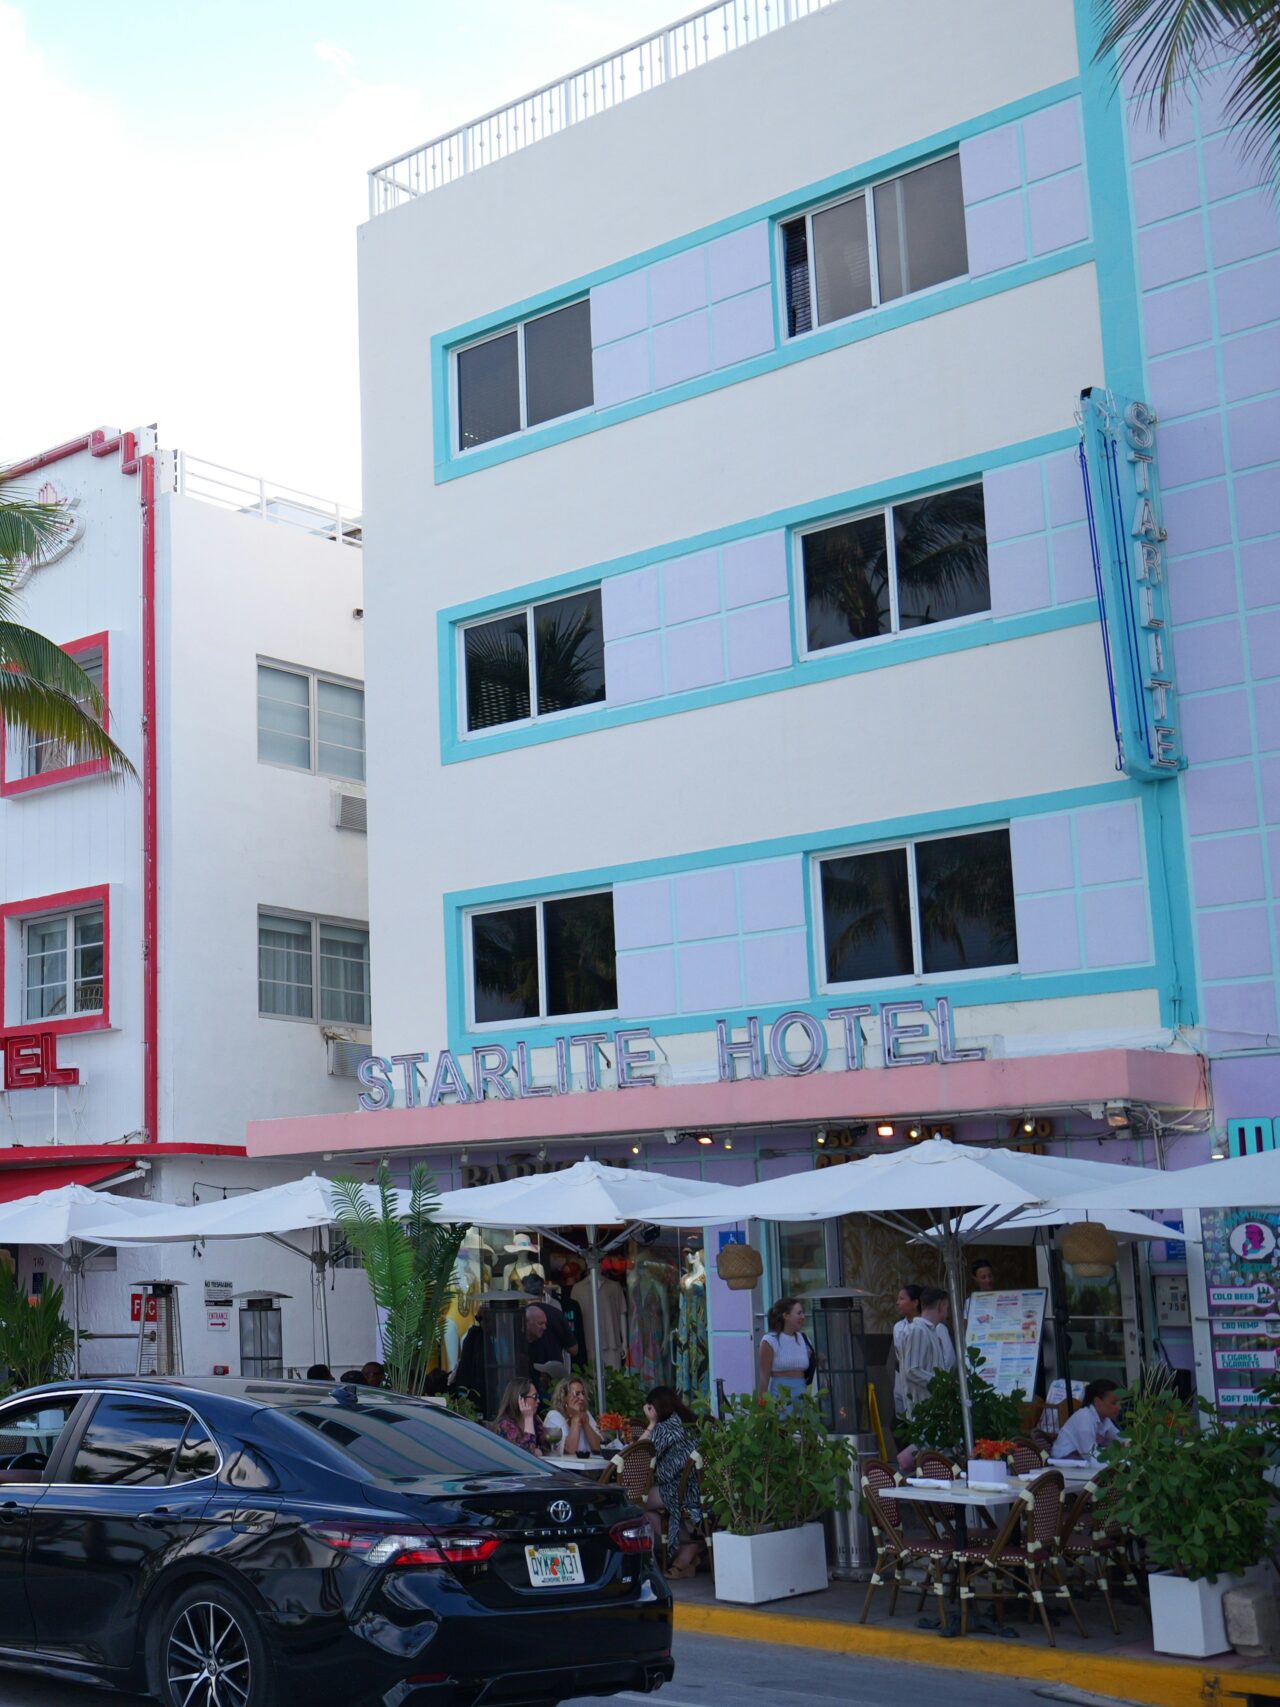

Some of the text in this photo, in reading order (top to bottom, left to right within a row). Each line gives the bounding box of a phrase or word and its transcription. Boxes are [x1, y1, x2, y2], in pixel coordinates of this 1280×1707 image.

[1123, 402, 1177, 769] STARLITE
[357, 997, 986, 1112] STARLITE HOTEL
[134, 1301, 156, 1316] FC
[208, 1312, 229, 1320] ENTRANCE
[1237, 1321, 1259, 1329] HEMP
[1221, 1394, 1240, 1402] SOFT
